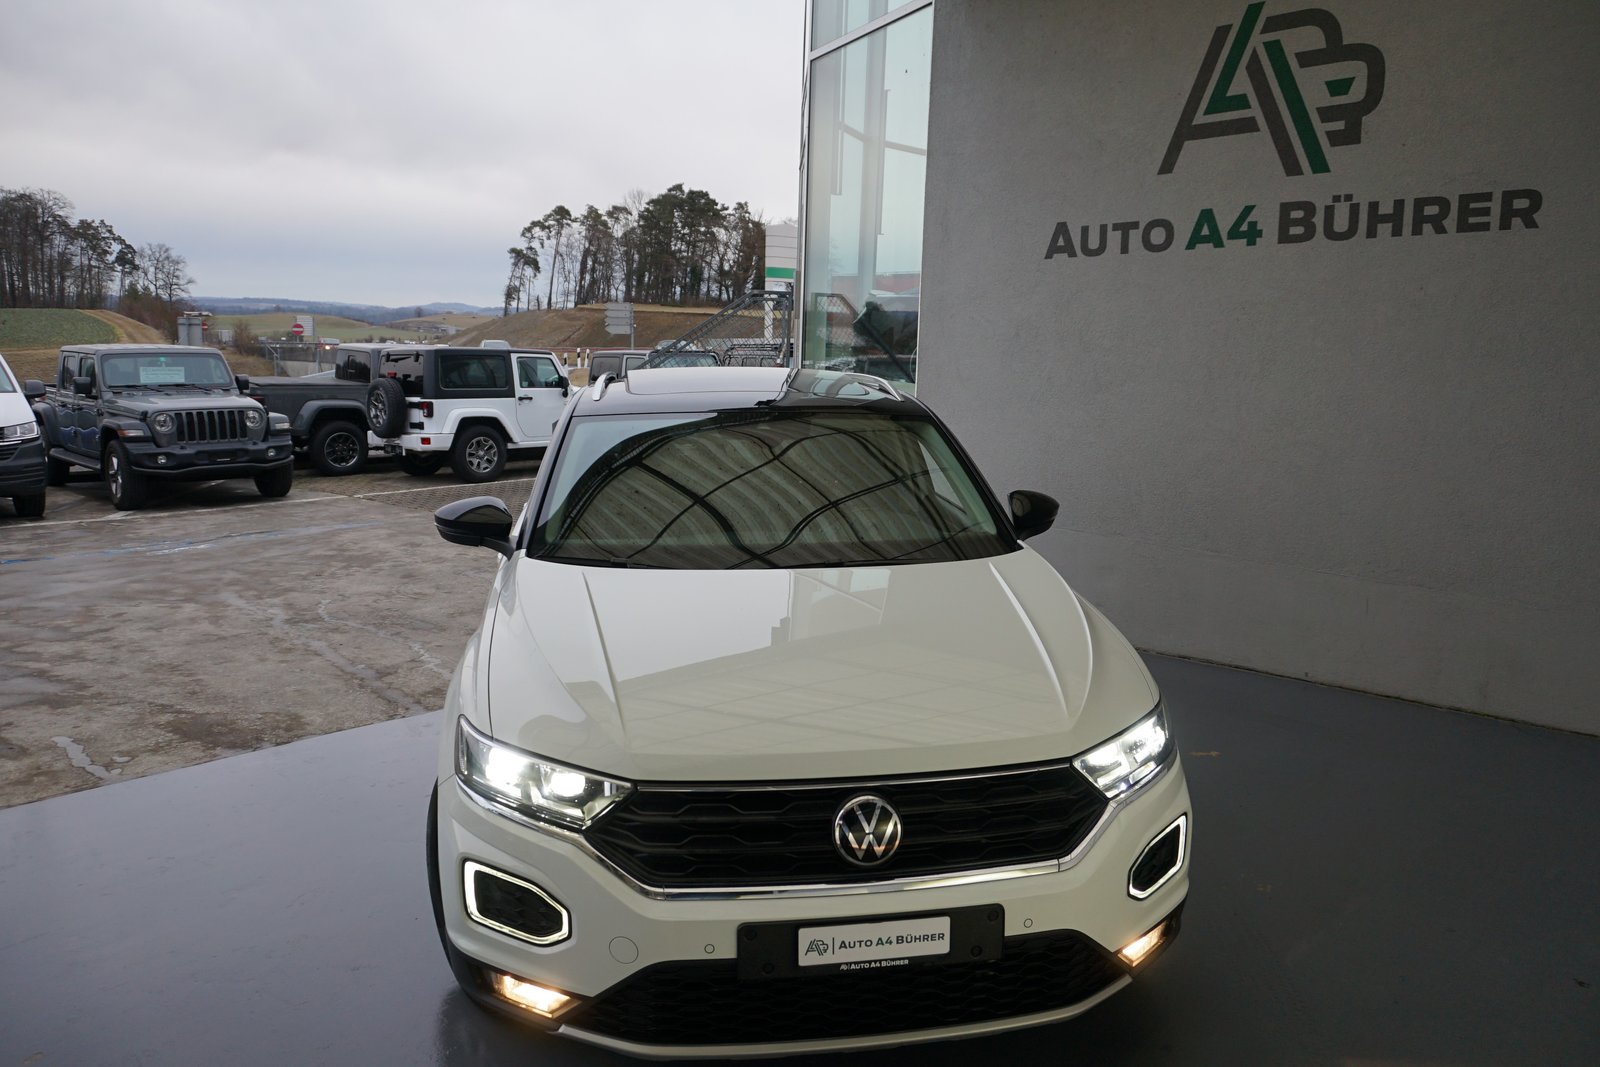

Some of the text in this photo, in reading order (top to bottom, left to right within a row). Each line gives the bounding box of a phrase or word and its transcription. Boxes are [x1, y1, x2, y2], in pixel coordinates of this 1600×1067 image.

[1044, 188, 1544, 260] AUTO A4 BÜHRER
[838, 939, 873, 950] AUTO
[875, 936, 894, 947] A4
[895, 933, 945, 945] BÜHRER
[850, 962, 870, 970] AUTO
[881, 959, 909, 967] BÜHRER
